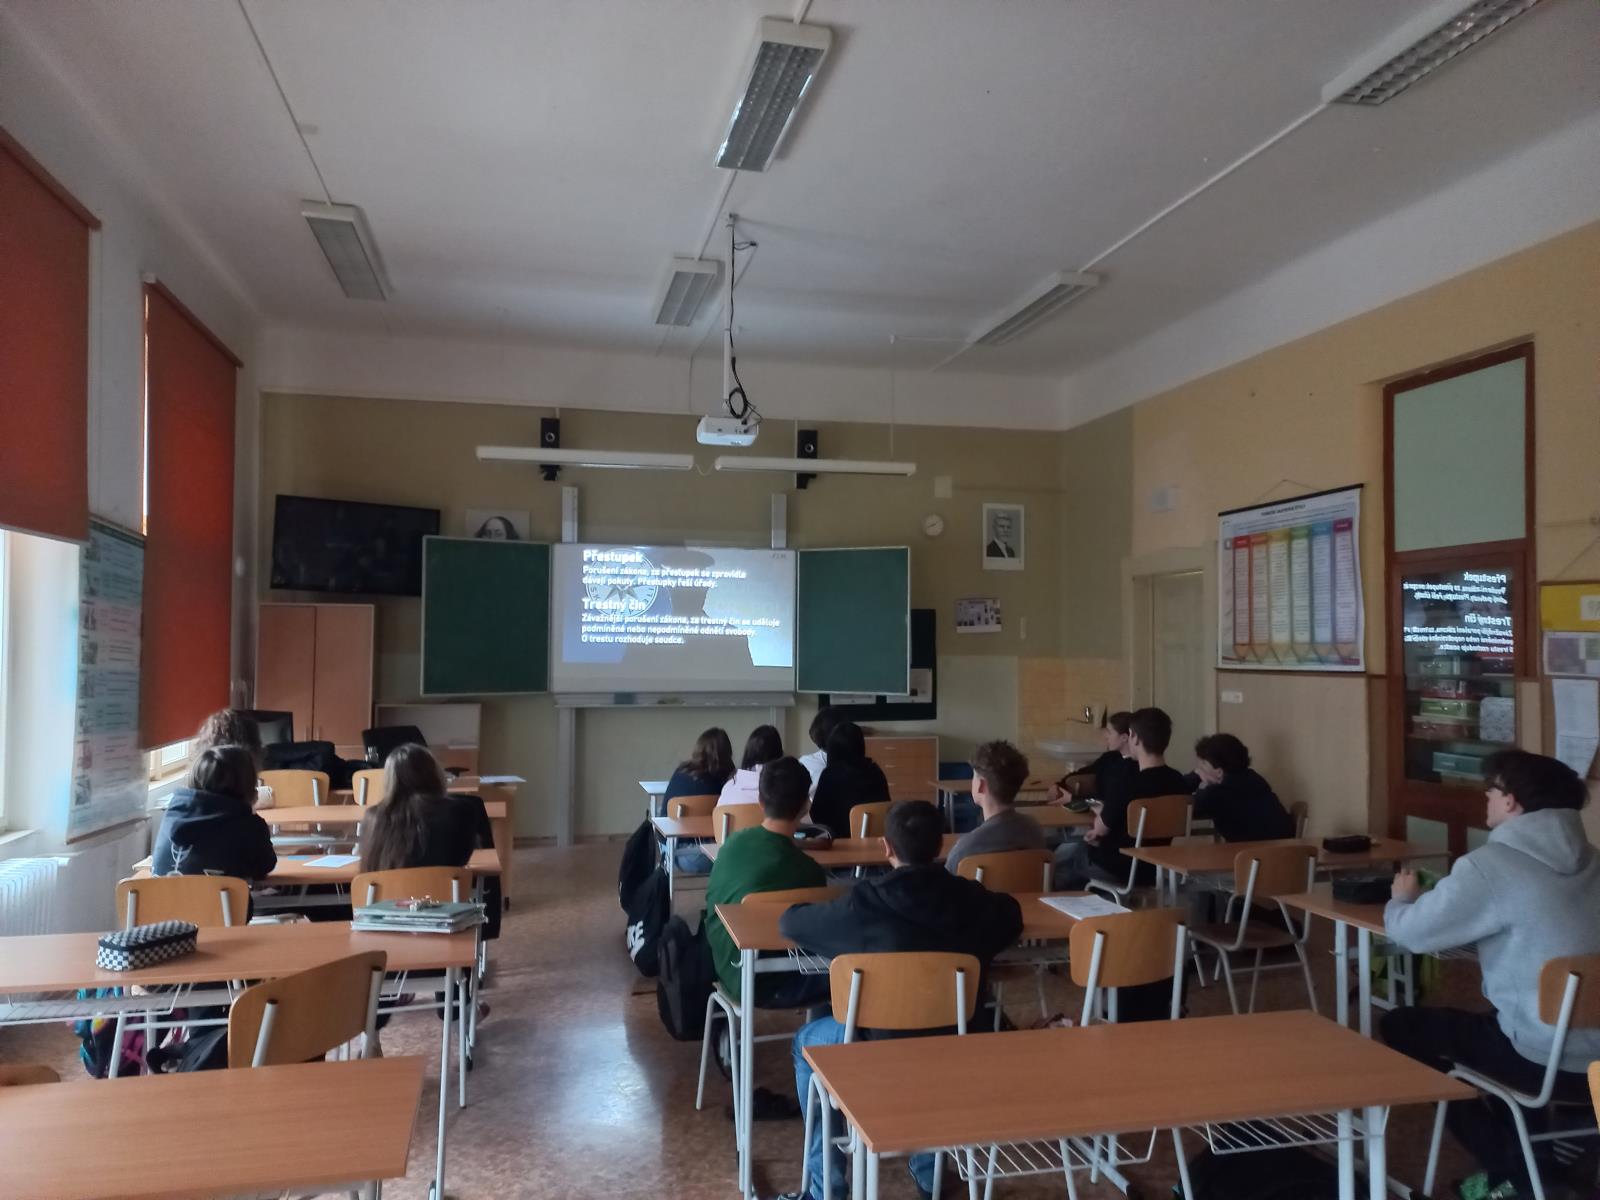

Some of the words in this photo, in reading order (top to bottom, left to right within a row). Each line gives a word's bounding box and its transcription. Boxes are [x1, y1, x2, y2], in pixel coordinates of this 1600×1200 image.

[583, 550, 643, 564] Přestupek
[583, 565, 618, 574] Porušení
[661, 568, 700, 577] přestupek
[582, 576, 605, 585] dávají
[608, 577, 636, 586] pokuty.
[638, 578, 676, 587] Přestupky
[678, 578, 692, 587] řeší
[694, 579, 718, 588] úřady.
[582, 598, 627, 612] Trestný
[629, 599, 646, 610] čin
[581, 613, 622, 623] Závažnější
[625, 614, 658, 624] porušení
[701, 616, 727, 626] trestný
[581, 624, 624, 634] podmíněné
[627, 625, 645, 633] nebo
[648, 626, 699, 635] nepodmíněné
[700, 626, 724, 635] odnětí
[589, 635, 613, 643] trestu
[615, 636, 653, 645] rozhoduje
[655, 636, 684, 644] soudce.
